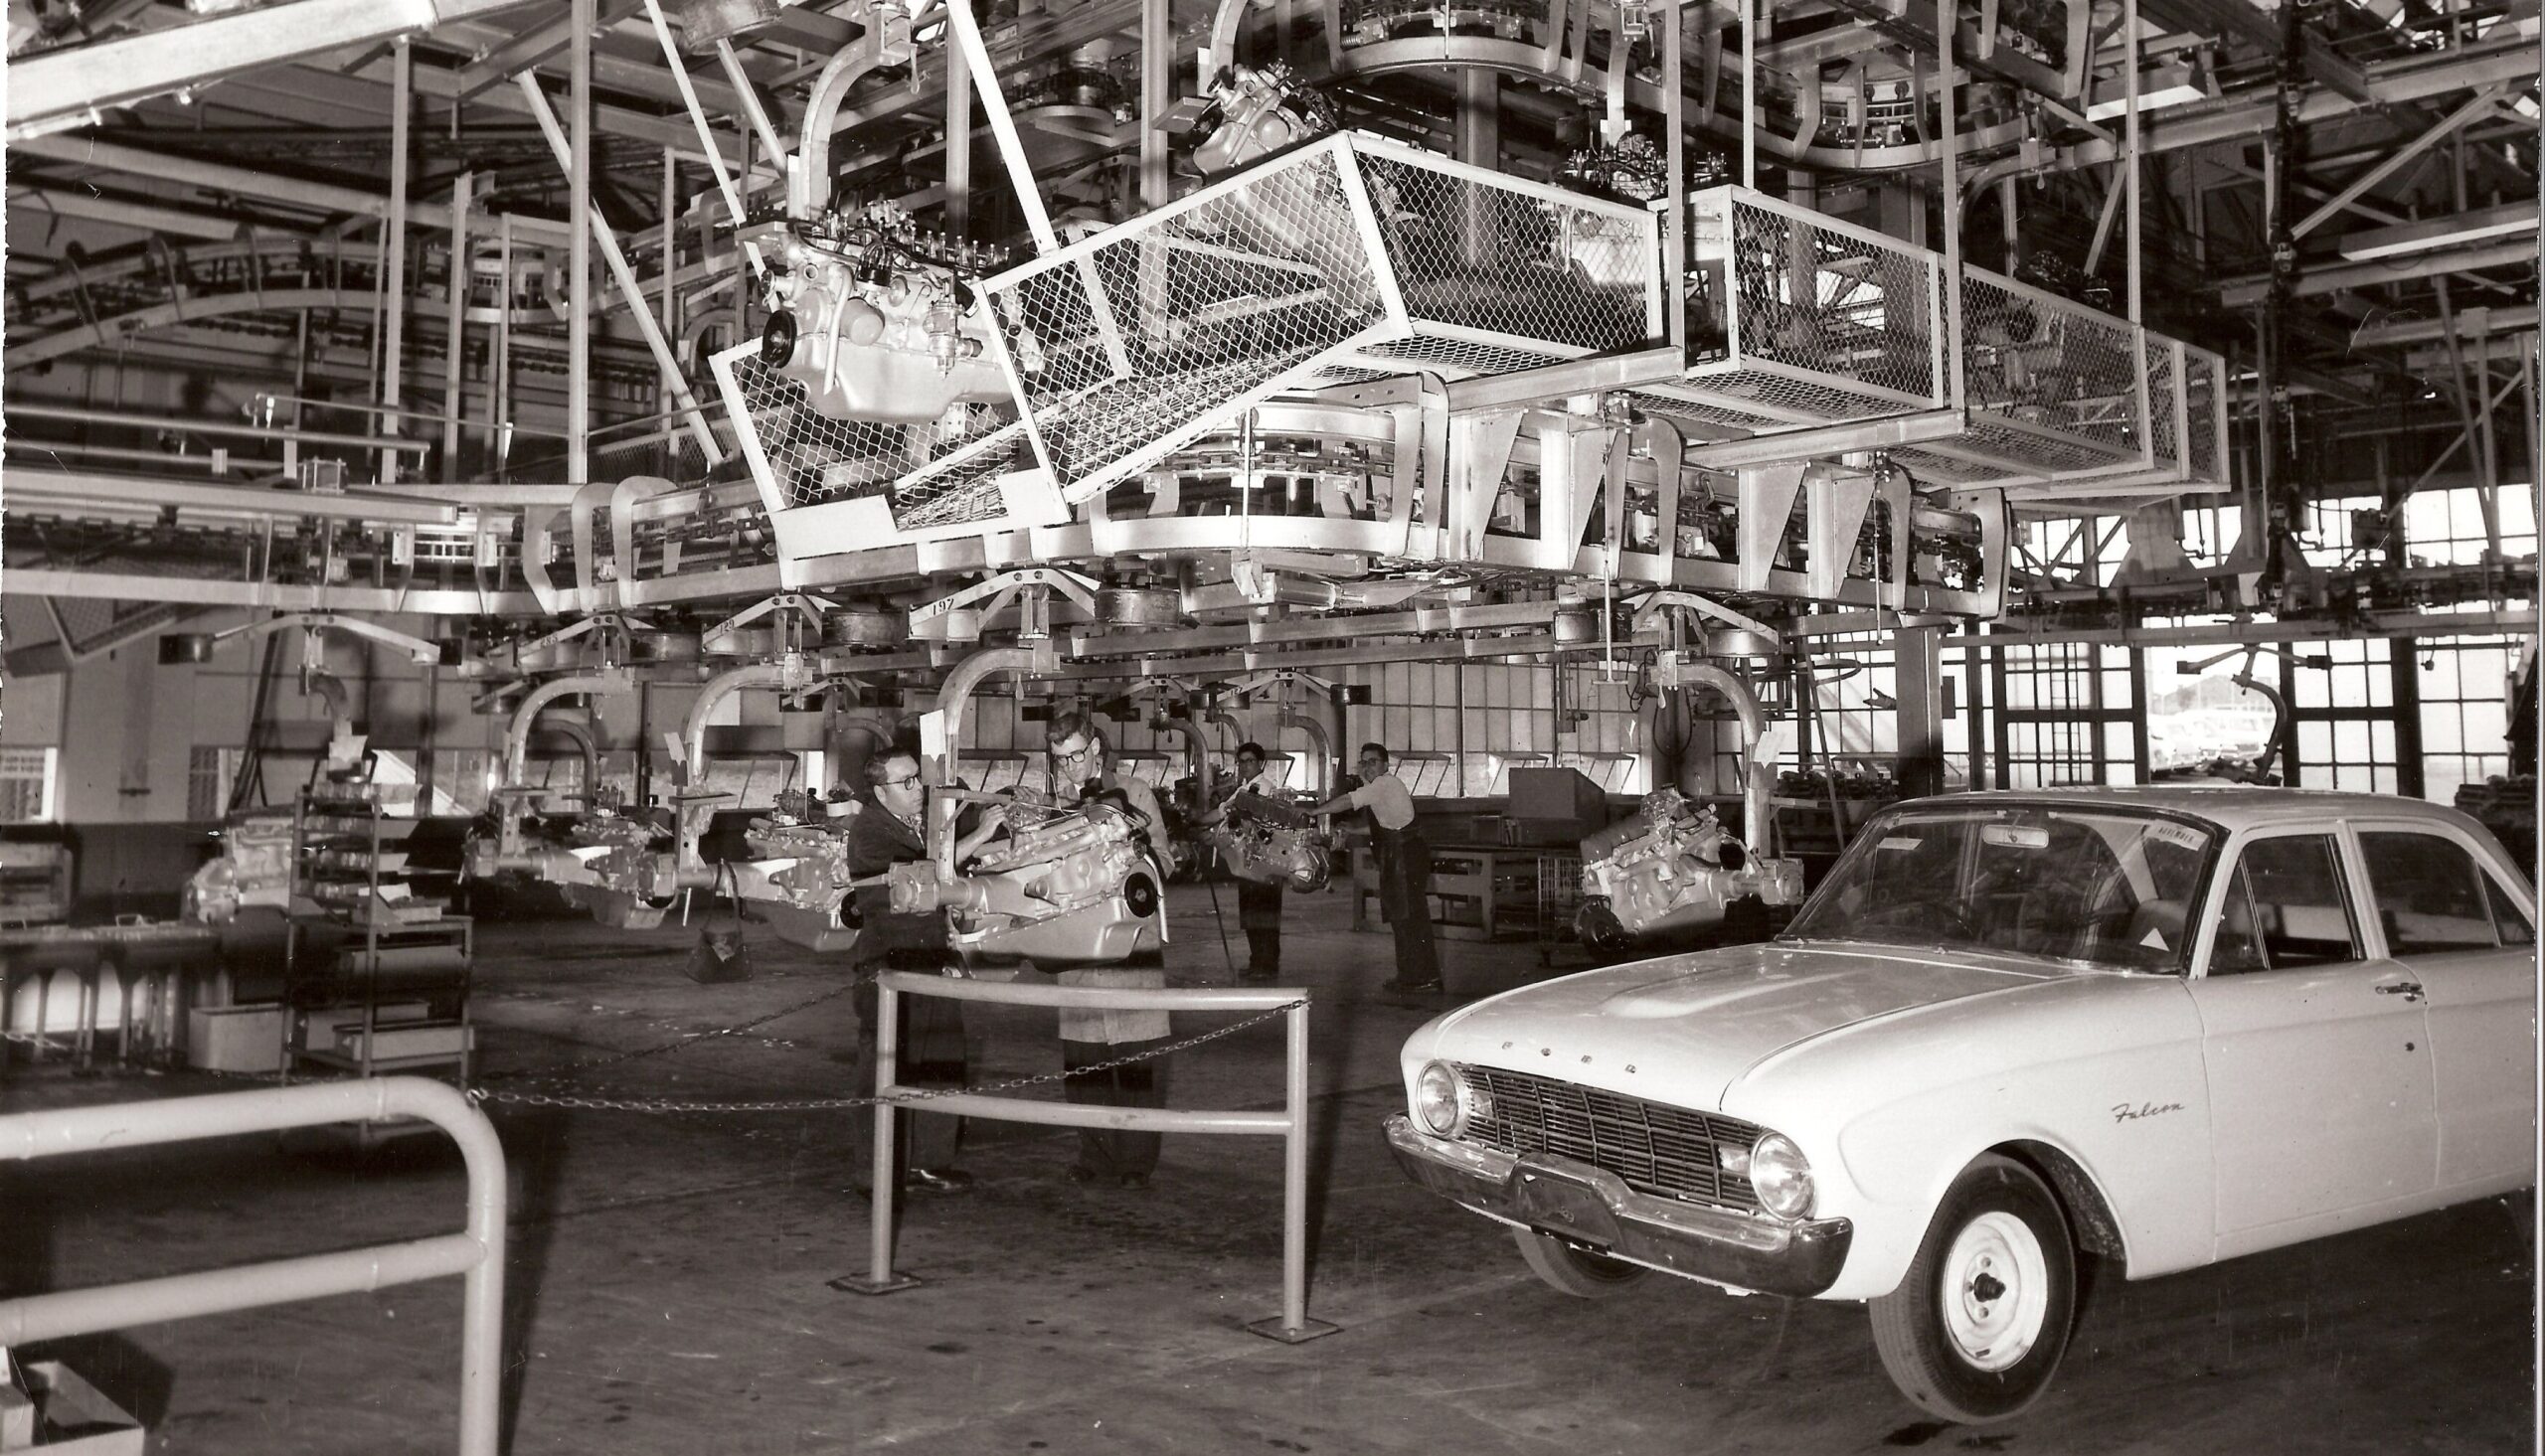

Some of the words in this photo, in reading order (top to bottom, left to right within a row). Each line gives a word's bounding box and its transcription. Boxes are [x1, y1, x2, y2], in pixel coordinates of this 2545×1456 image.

[933, 598, 954, 615] 197
[720, 618, 735, 634] 129
[1501, 1041, 1636, 1073] FORD
[2112, 1101, 2185, 1123] Falcon
